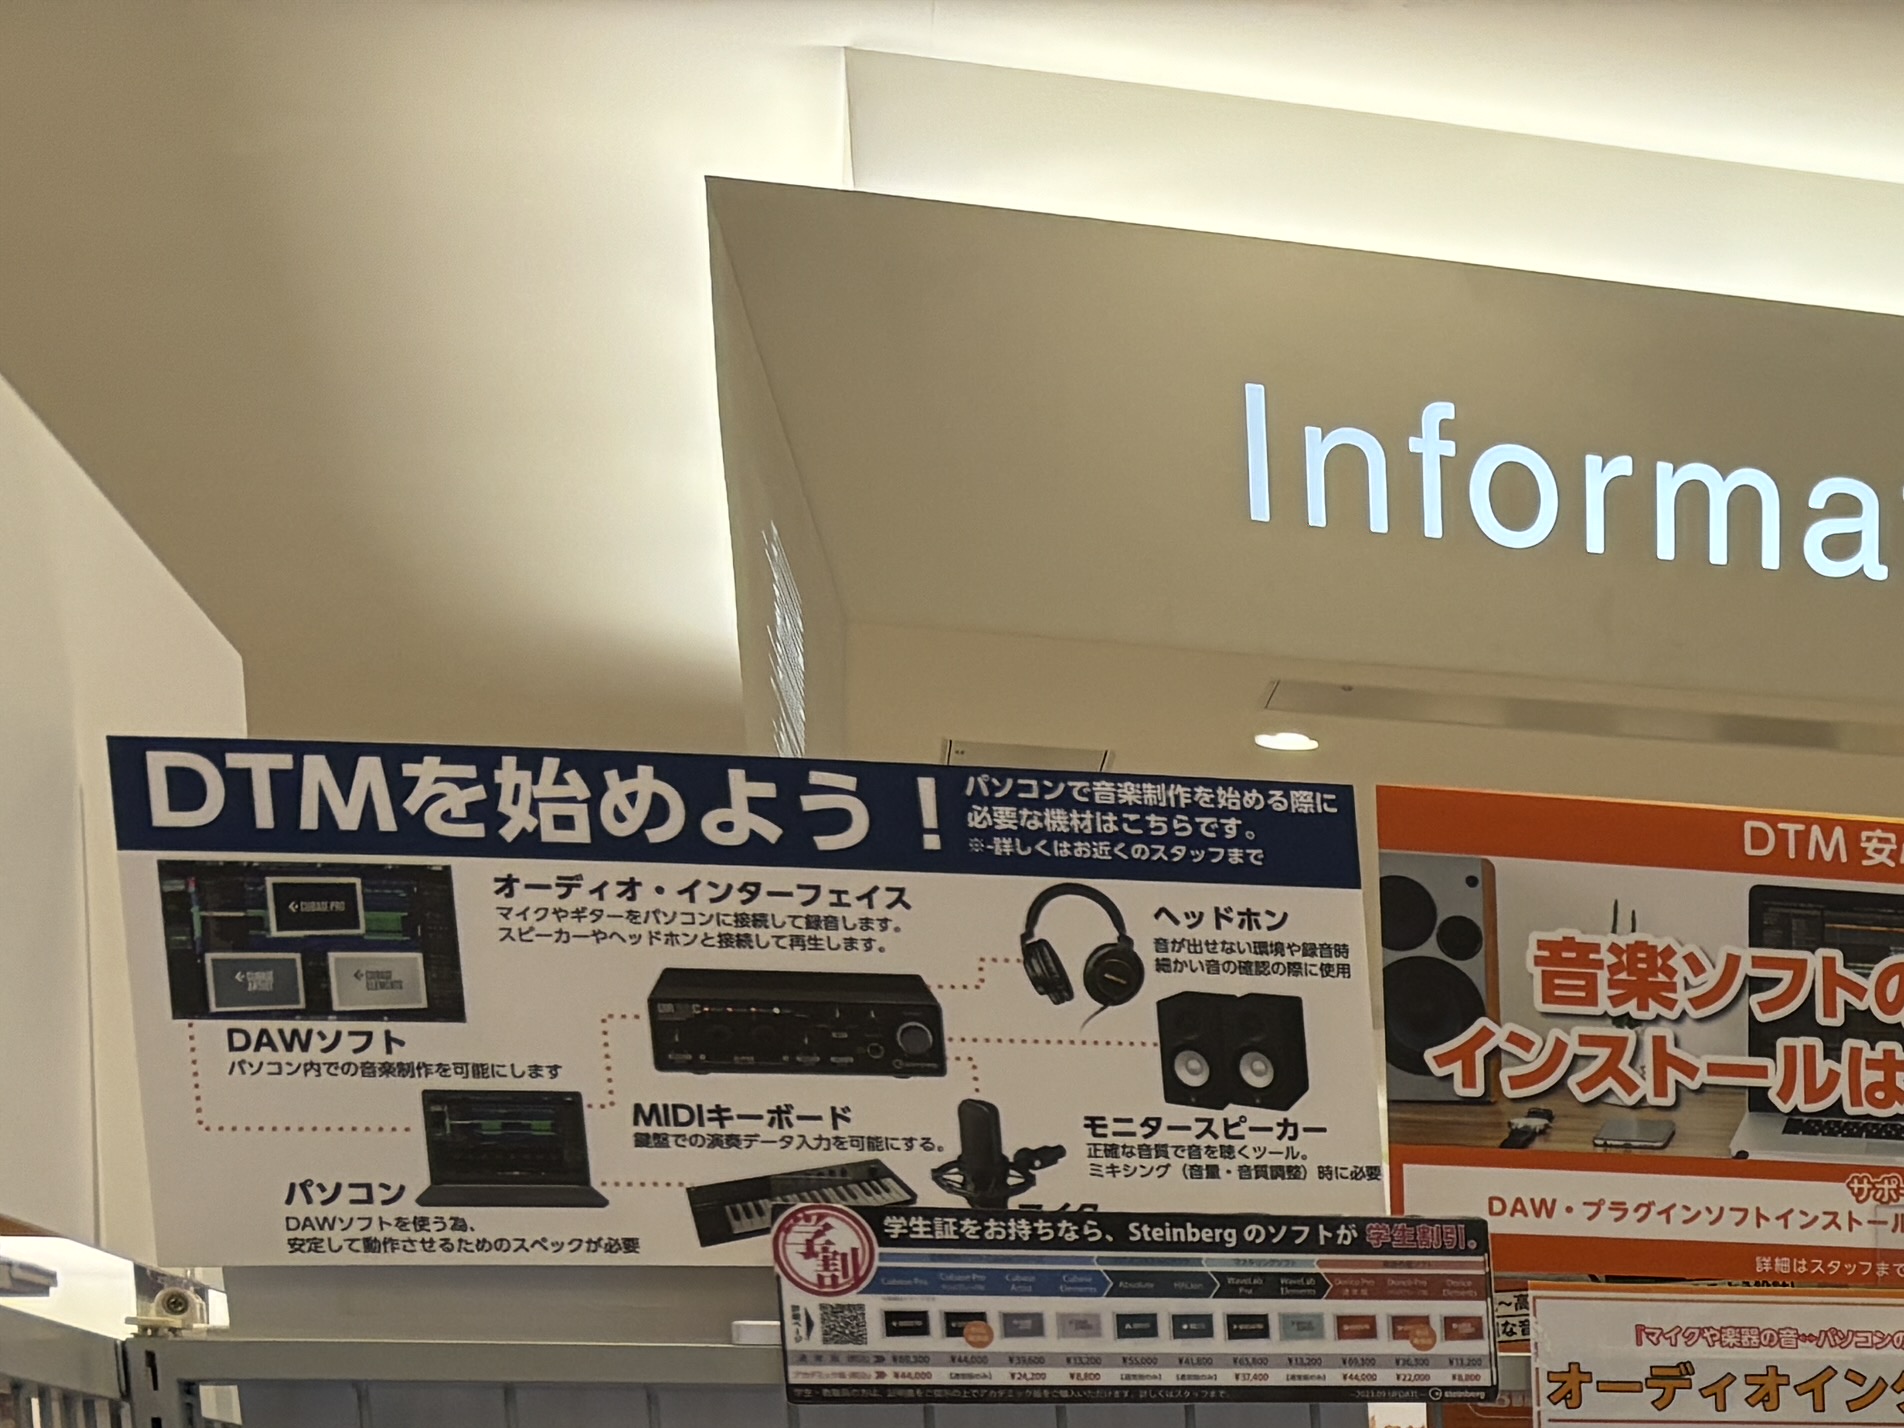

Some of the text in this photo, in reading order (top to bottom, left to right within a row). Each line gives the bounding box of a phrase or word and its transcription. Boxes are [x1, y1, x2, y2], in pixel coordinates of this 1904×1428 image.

[145, 750, 942, 852] DTMを始めよう！
[965, 774, 1338, 814] パソコンで音楽制作を始める際に
[967, 803, 1258, 841] 必要な機材はこちらです。
[1743, 820, 1849, 864] DTM
[493, 872, 912, 911] オーディオ・インターフェイス
[495, 905, 902, 935] マイクやギターをパソコンに接続して録音します。
[1153, 904, 1290, 932] ヘッドホン
[498, 925, 888, 954] スピーカーやヘッドホンと接続して再生します。
[1154, 936, 1350, 961] 音が出せない環境や録音時
[1154, 957, 1352, 980] 細かい音の確認の際に使用
[226, 1027, 407, 1056] DAWソフト
[227, 1060, 563, 1081] パソコン内での音楽制作を可能にします
[632, 1102, 852, 1132] MIDIキーボード
[1082, 1115, 1328, 1142] モニタースピーカー
[633, 1131, 946, 1154] 鍵盤での演奏データ入力を可能にする。
[1086, 1142, 1308, 1163] 正確な音質で音を聴くツール。
[284, 1180, 407, 1208] パソコン
[286, 1236, 642, 1256] 安定して動作させるためのスペックが必要
[883, 1215, 1114, 1245] 学生証をお持ちなら、
[1128, 1220, 1238, 1248] Steinberg
[1244, 1223, 1359, 1247] のソフトが
